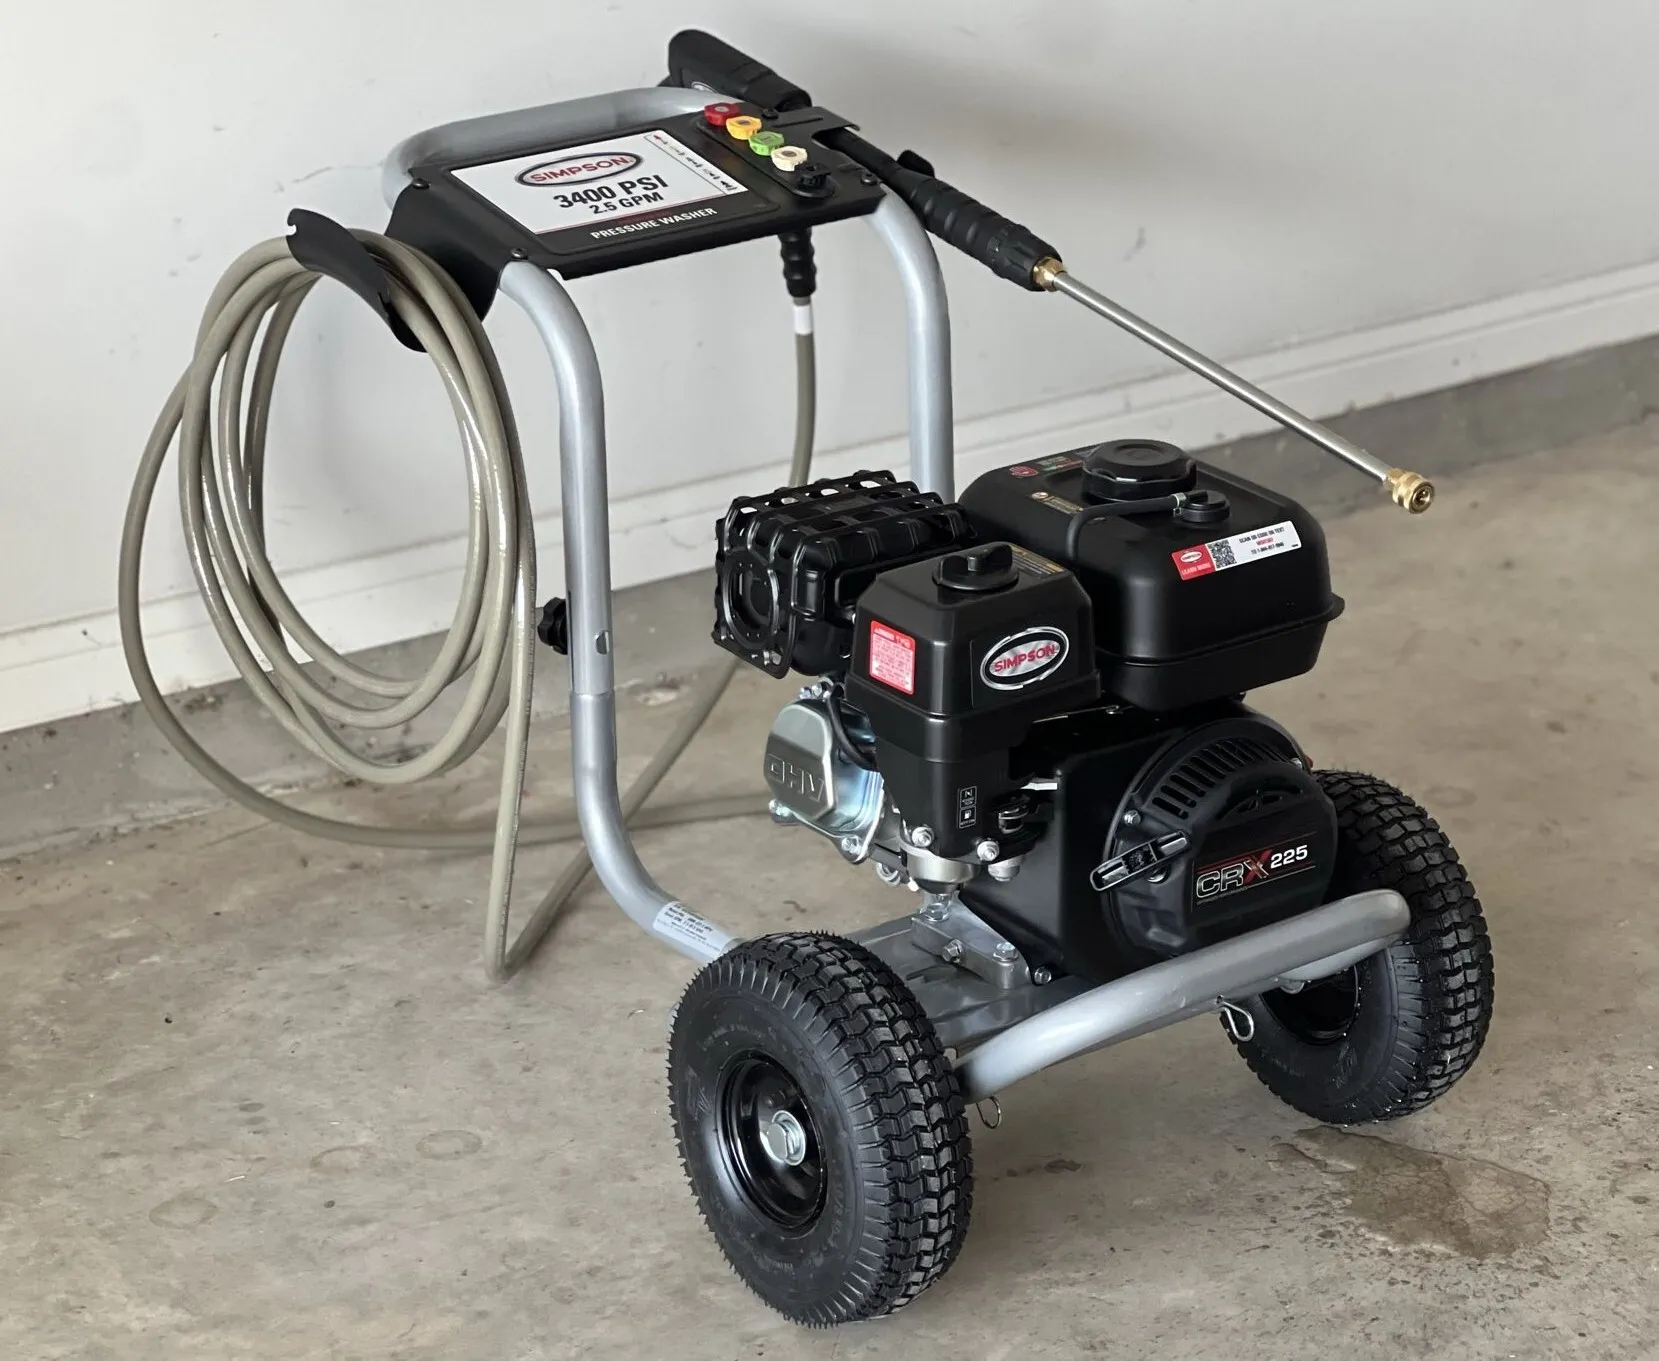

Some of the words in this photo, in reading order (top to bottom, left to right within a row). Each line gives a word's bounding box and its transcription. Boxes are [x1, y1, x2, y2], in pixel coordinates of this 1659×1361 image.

[530, 156, 629, 183] SIMPSON
[553, 185, 617, 209] 3400
[618, 174, 669, 195] PSI
[589, 201, 617, 214] 2.5
[619, 191, 664, 208] GPM
[590, 219, 660, 239] PRESSURE
[658, 207, 718, 225] WASHER
[994, 643, 1056, 672] SIMPSON
[765, 753, 825, 803] OHV
[1196, 849, 1272, 899] CRX
[1270, 844, 1308, 869] 225
